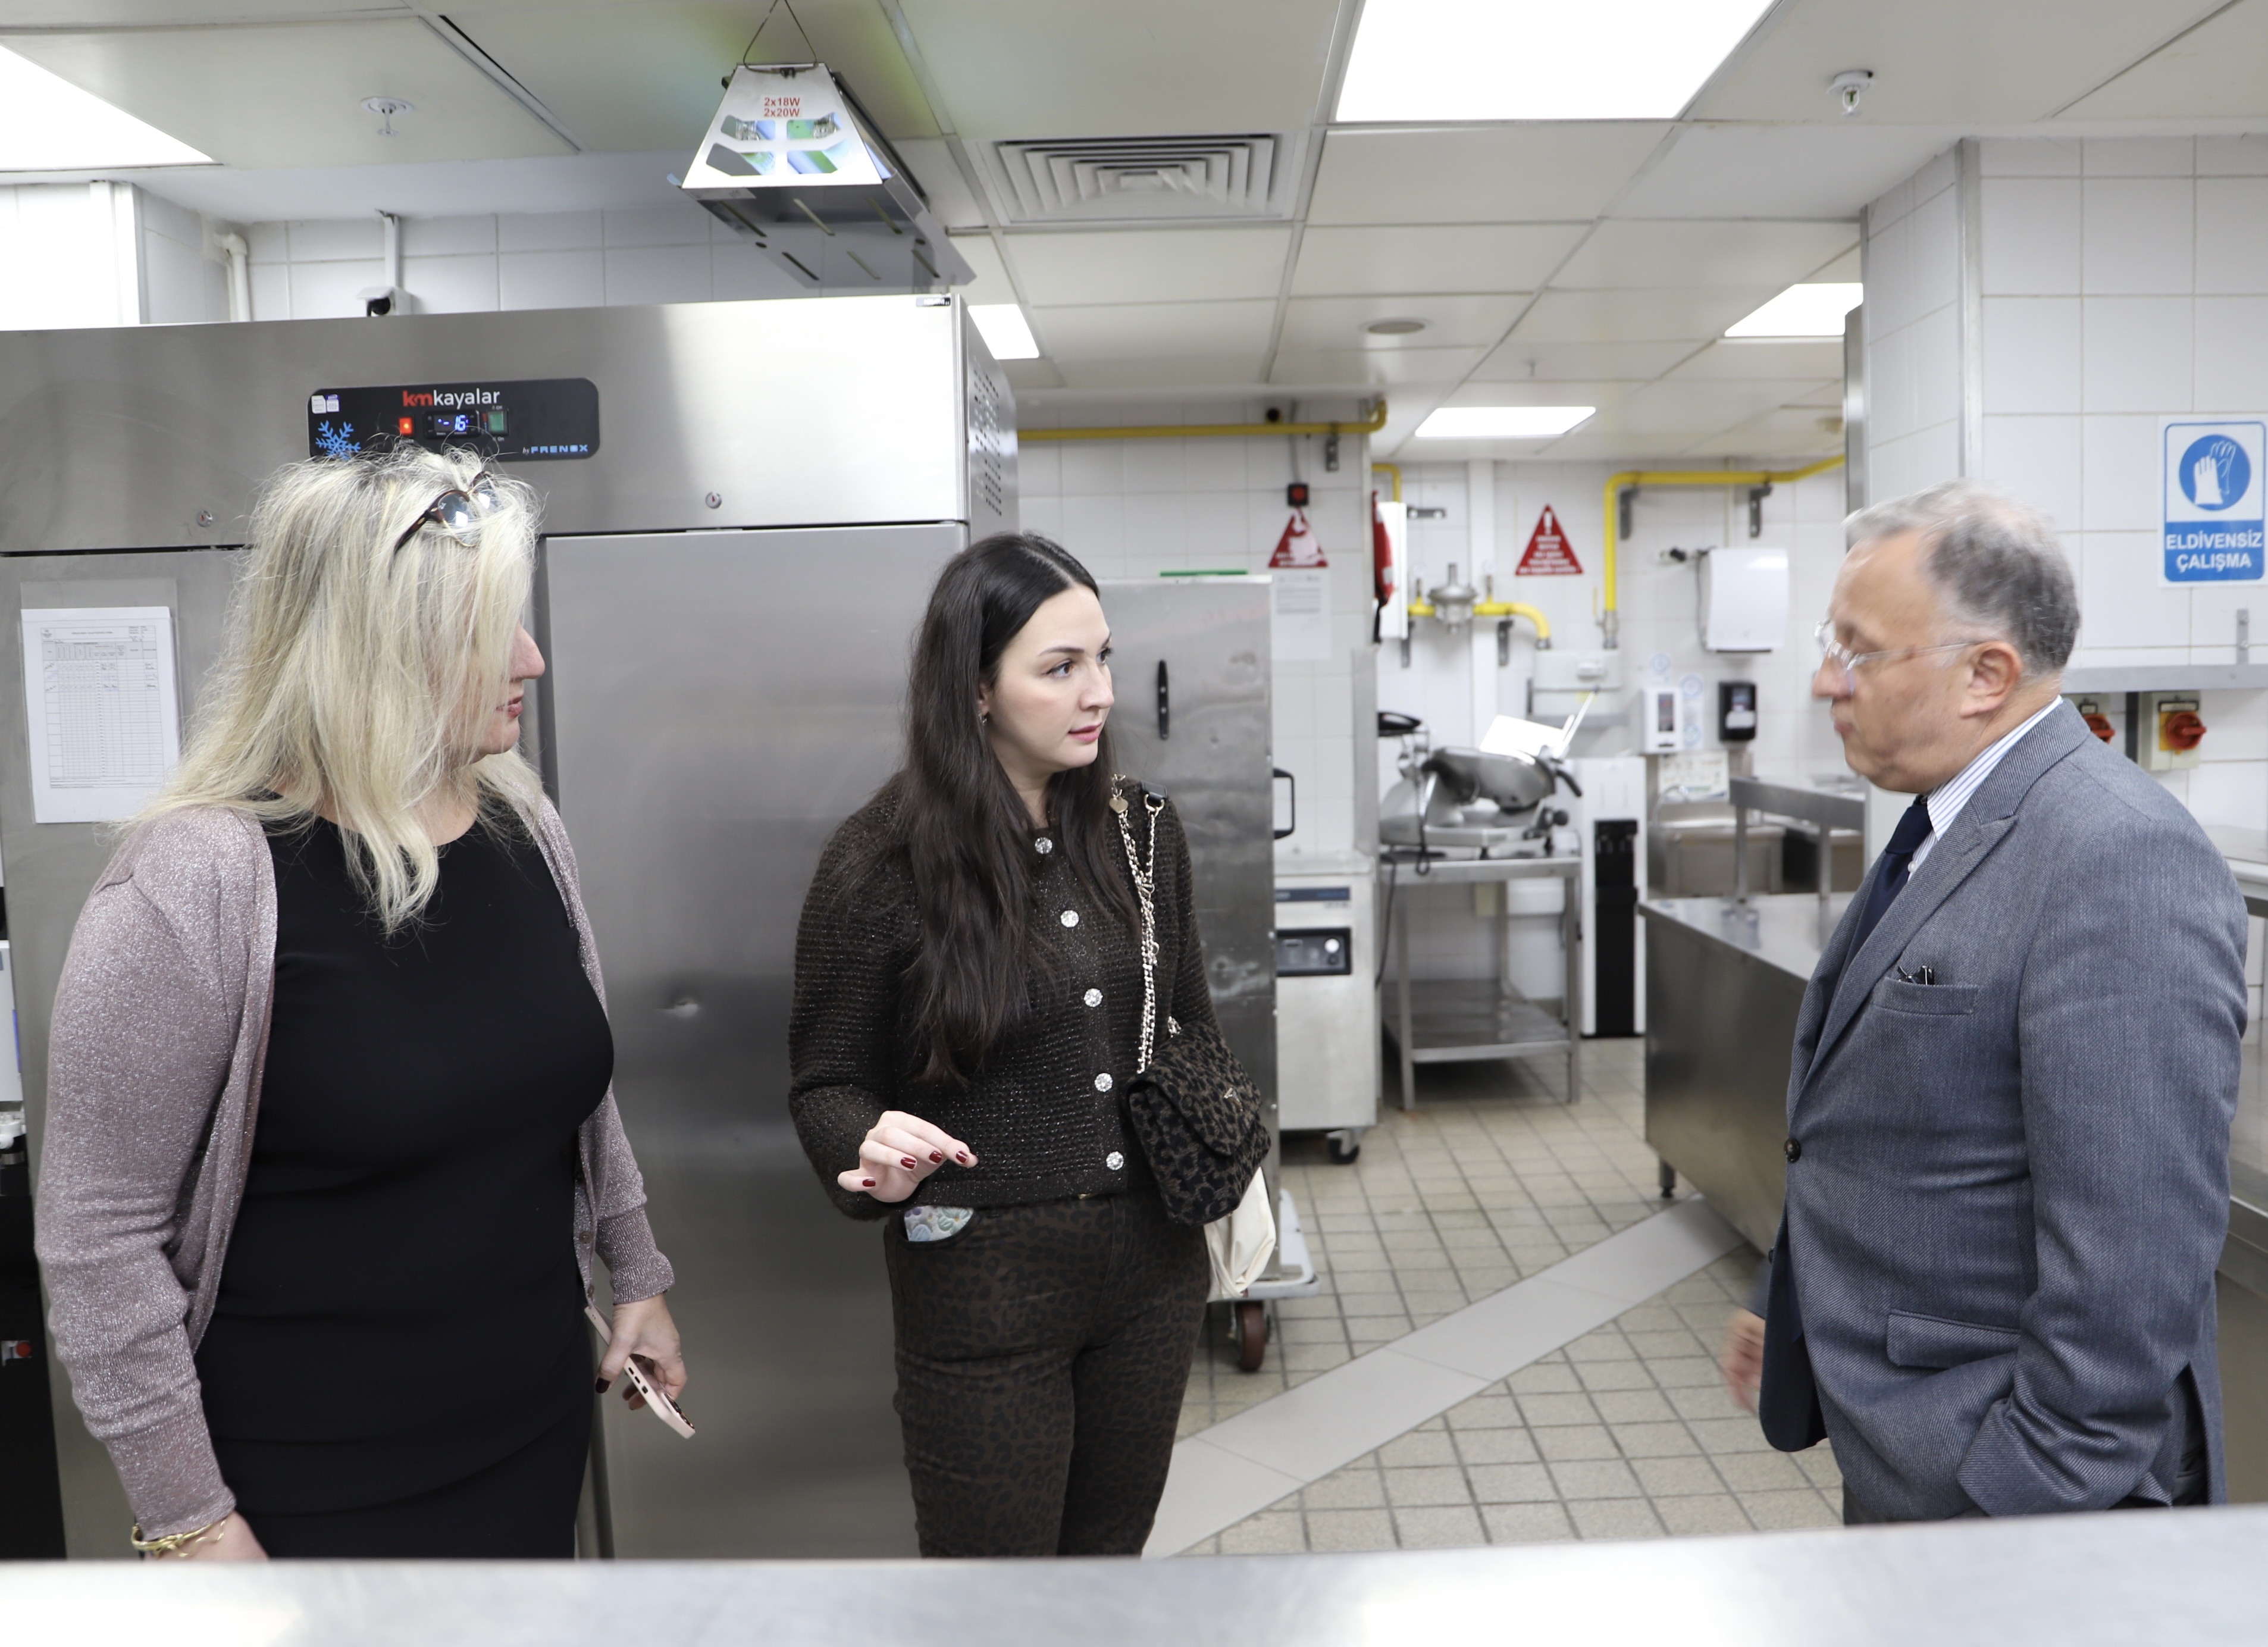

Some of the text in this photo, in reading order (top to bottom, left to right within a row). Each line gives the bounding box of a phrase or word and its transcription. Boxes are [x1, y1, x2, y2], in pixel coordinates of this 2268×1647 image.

[764, 97, 800, 107] 2x18W
[764, 108, 800, 117] 2x20W
[522, 444, 588, 456] by FRENOX
[2166, 529, 2263, 550] ELDİVENSİZ
[2176, 553, 2253, 574] ÇALIŞMA
